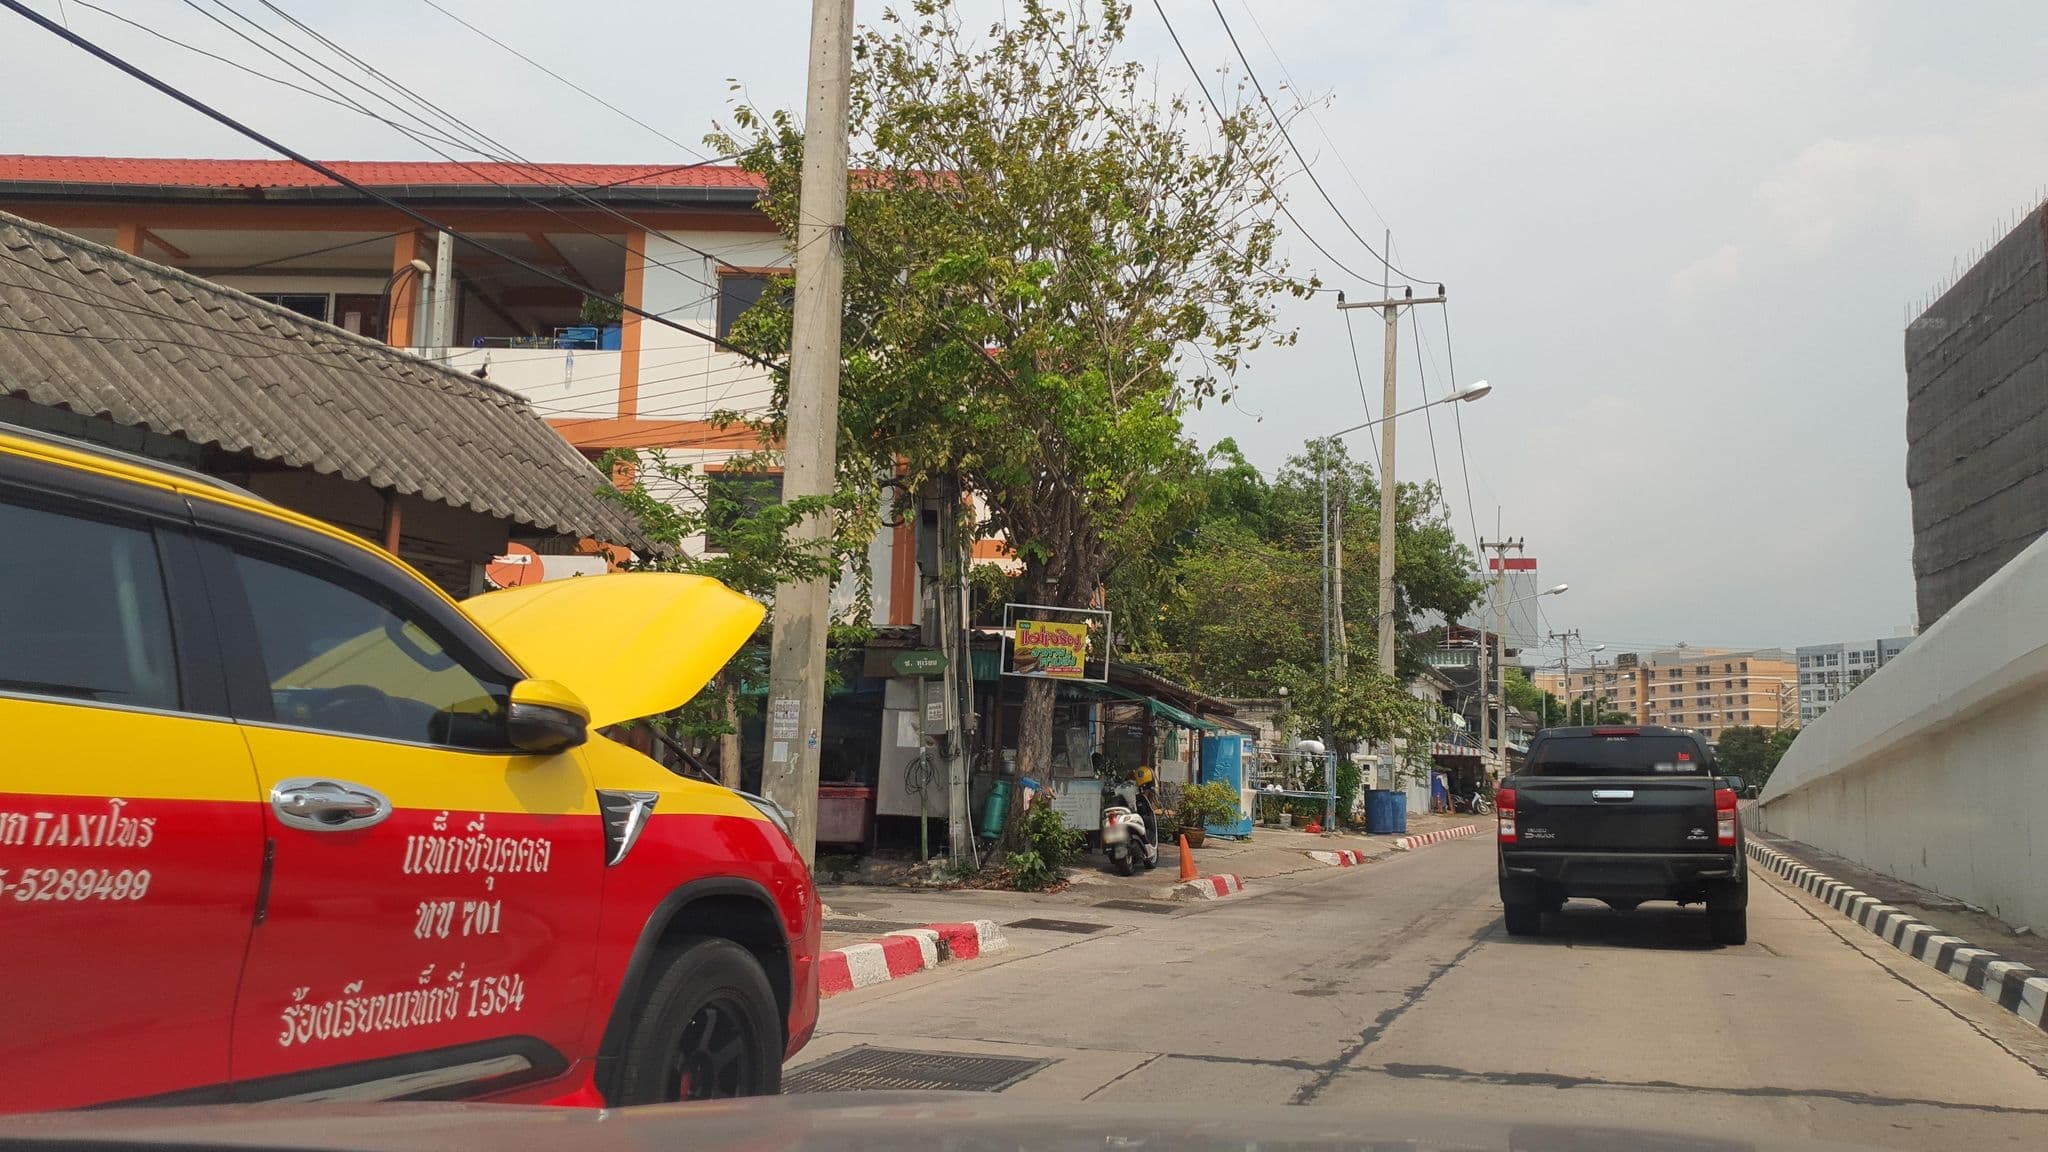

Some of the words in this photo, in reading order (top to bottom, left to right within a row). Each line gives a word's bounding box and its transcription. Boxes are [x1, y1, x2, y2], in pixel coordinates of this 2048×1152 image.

[403, 811, 551, 891] แท็กซี่บุคคล
[462, 900, 501, 936] 701
[278, 962, 465, 1047] ร้องเรียนแท็กซี่
[467, 973, 525, 1017] 1584
